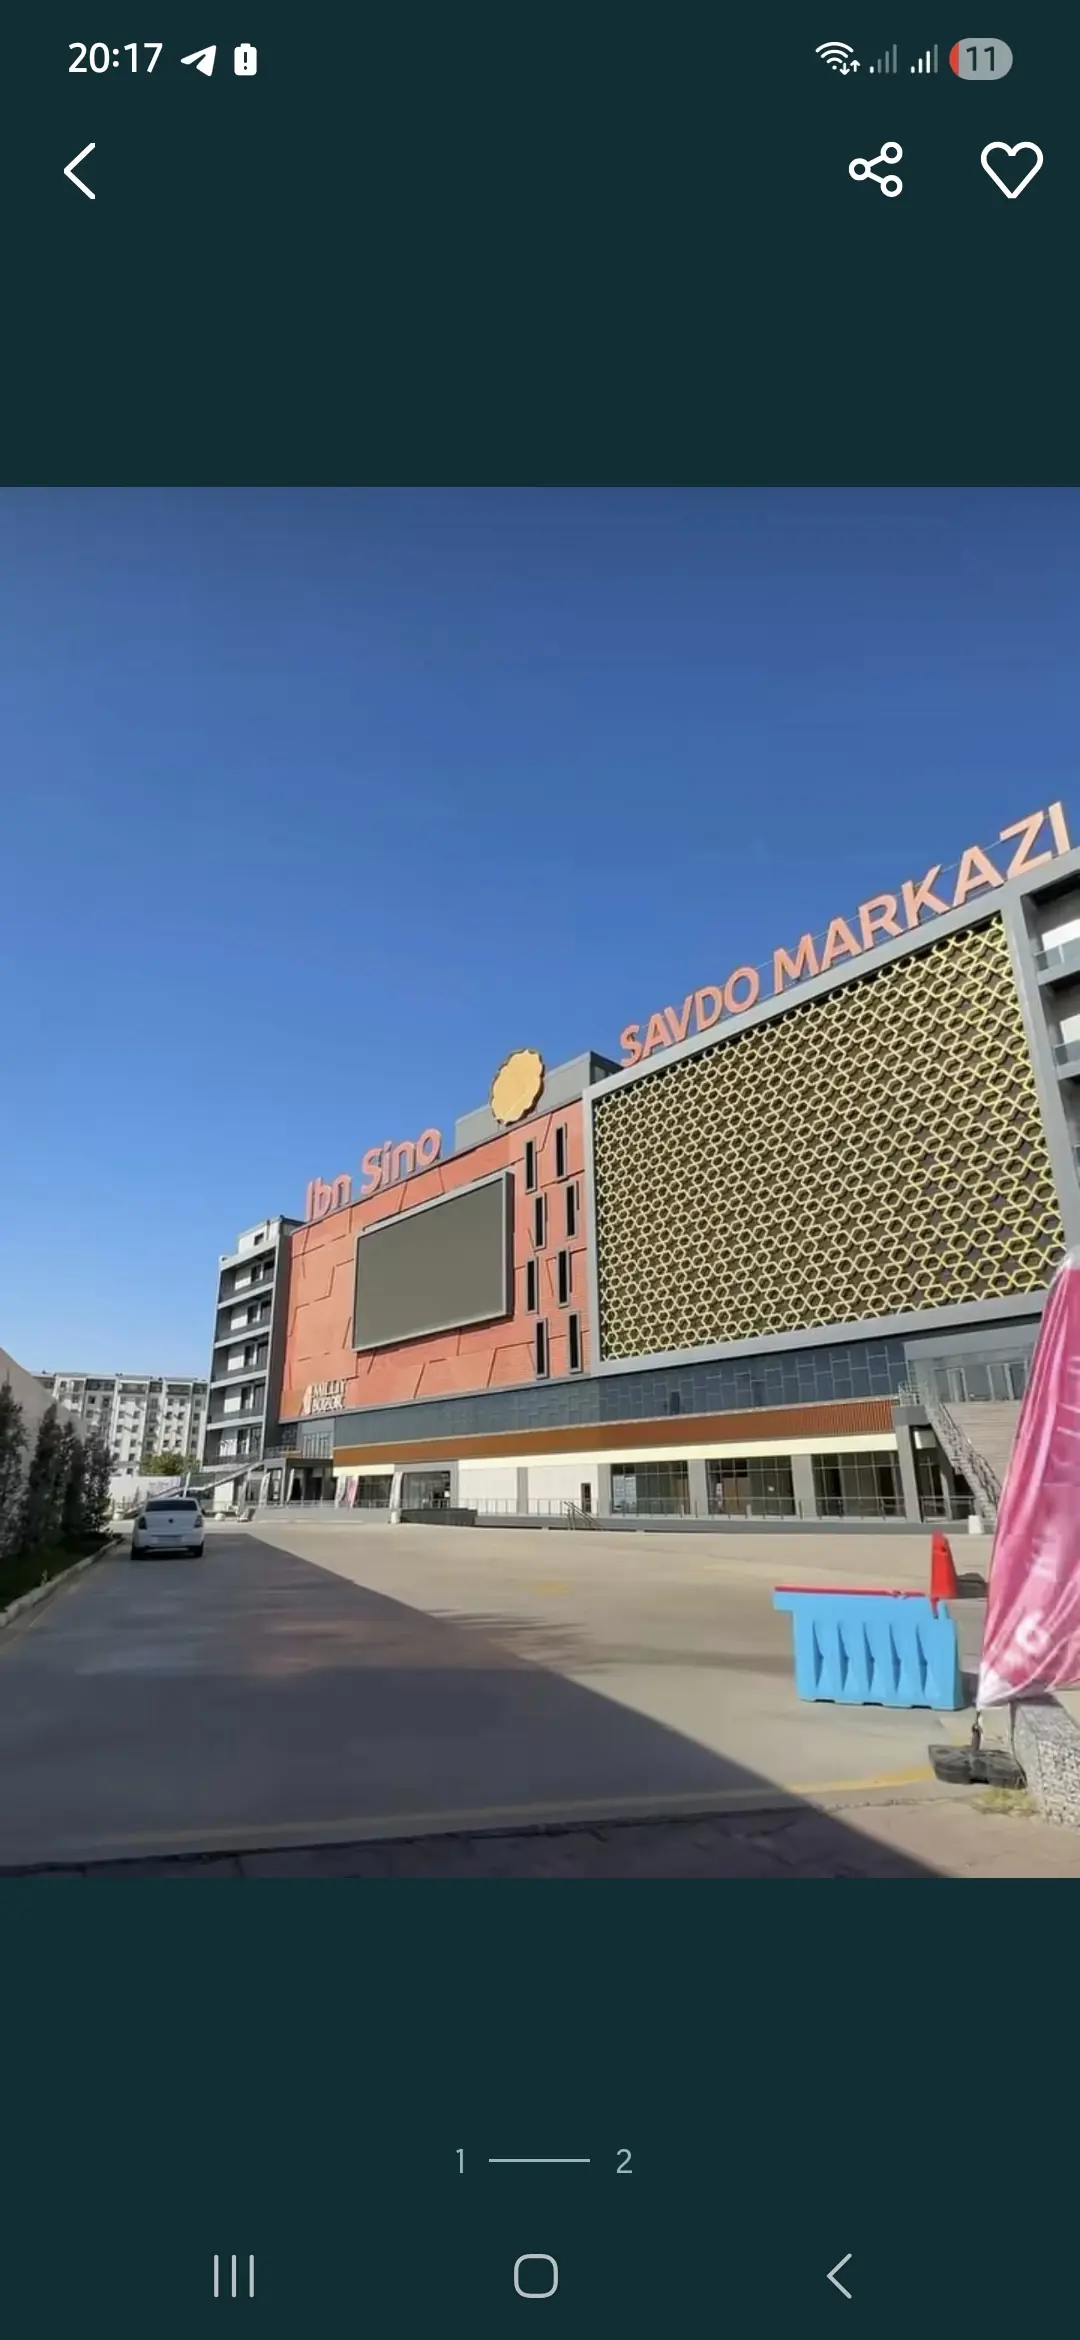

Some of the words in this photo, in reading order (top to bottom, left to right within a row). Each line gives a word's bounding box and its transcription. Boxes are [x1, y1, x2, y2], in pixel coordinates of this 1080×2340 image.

[620, 967, 760, 1068] SAVDO
[773, 801, 1071, 995] MARKAZI
[306, 1173, 352, 1222] Ibn
[361, 1128, 442, 1194] Sino
